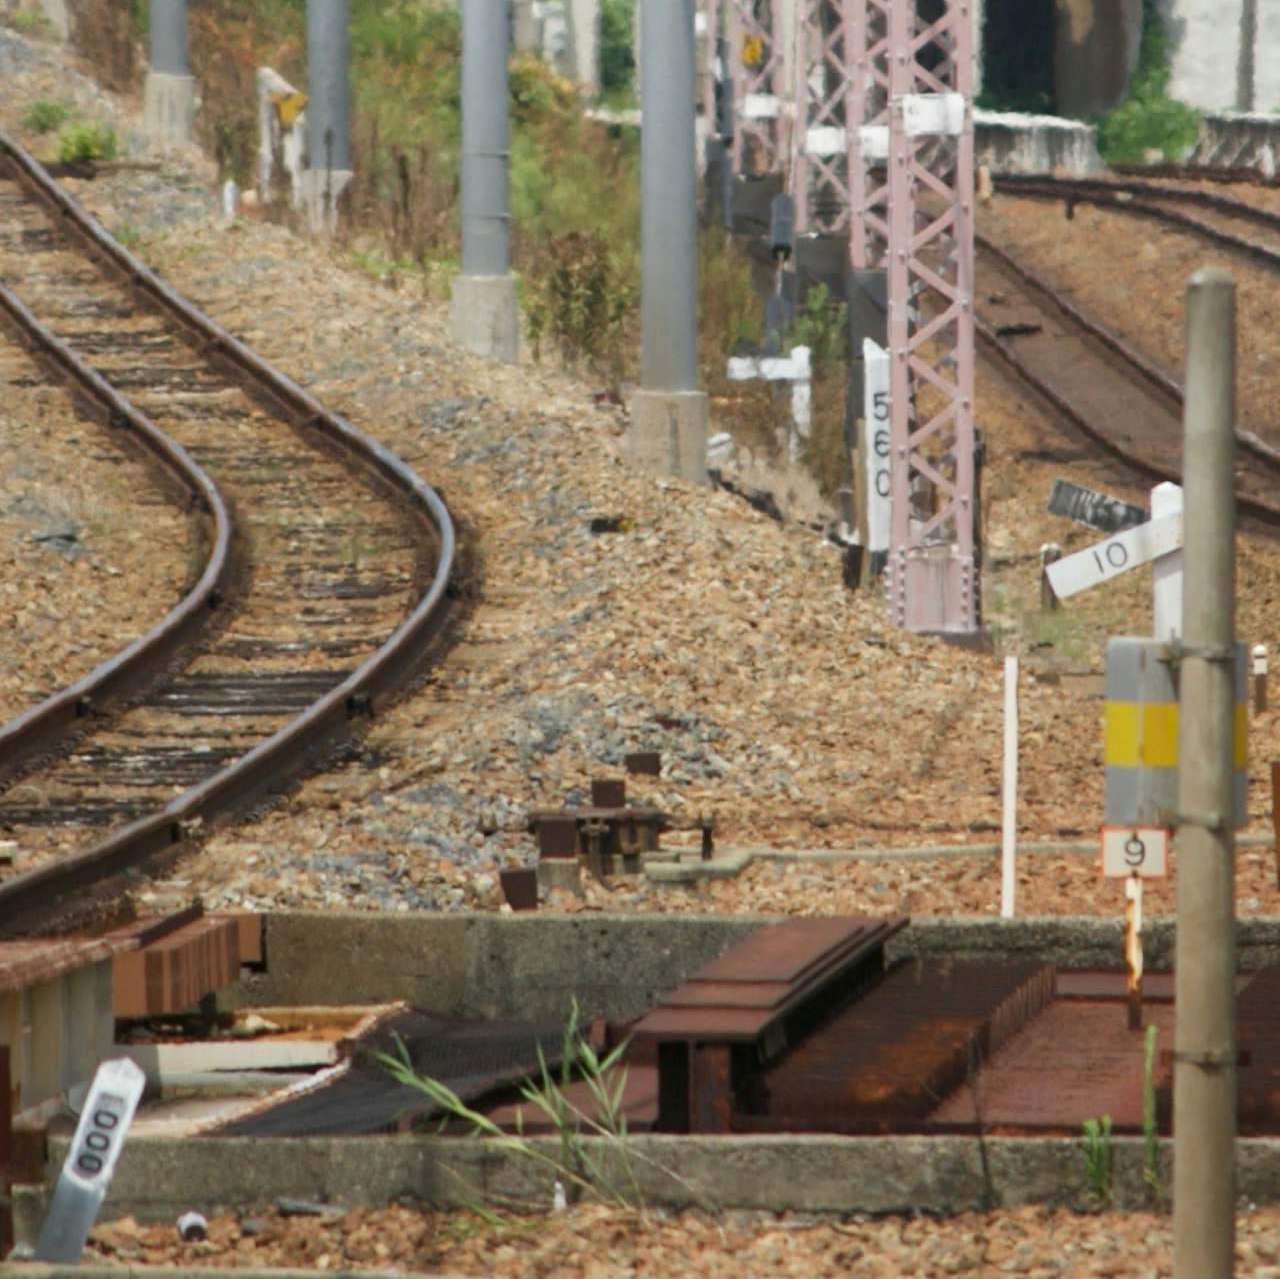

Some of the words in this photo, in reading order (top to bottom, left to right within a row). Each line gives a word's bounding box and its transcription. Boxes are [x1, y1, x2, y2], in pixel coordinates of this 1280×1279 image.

[873, 392, 891, 498] 560
[1092, 541, 1129, 574] 10
[1123, 837, 1146, 867] 9
